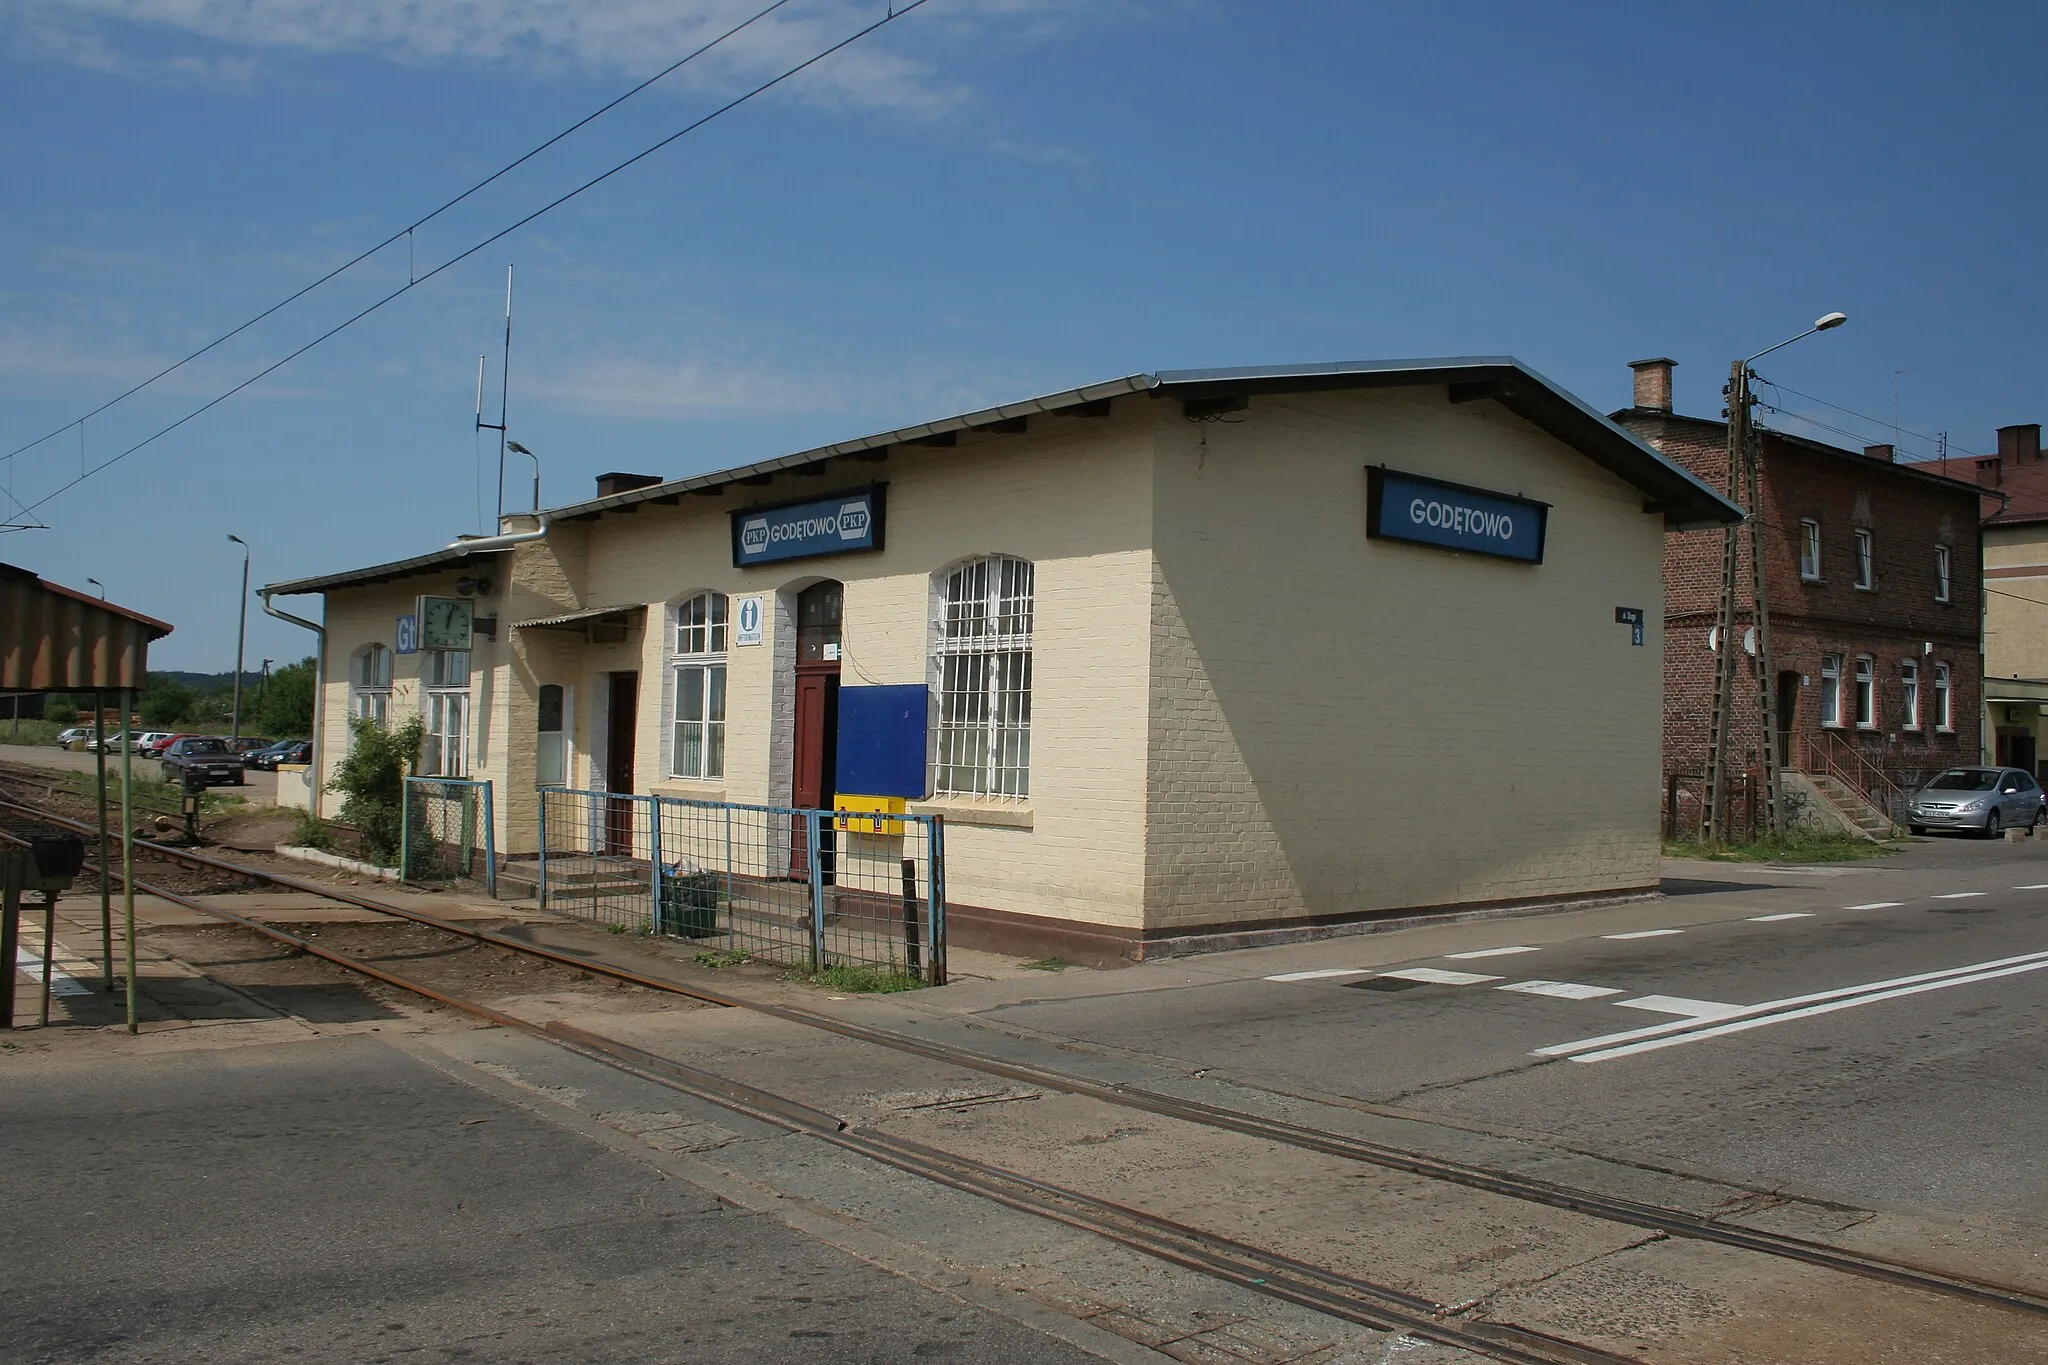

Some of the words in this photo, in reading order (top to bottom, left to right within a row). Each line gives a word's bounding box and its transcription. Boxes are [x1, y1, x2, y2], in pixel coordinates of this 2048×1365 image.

[746, 528, 766, 544] PKP
[770, 516, 836, 542] GODĘTOWO
[842, 513, 865, 530] PKP
[1409, 498, 1513, 541] GODĘTOWO
[1635, 629, 1641, 644] 3
